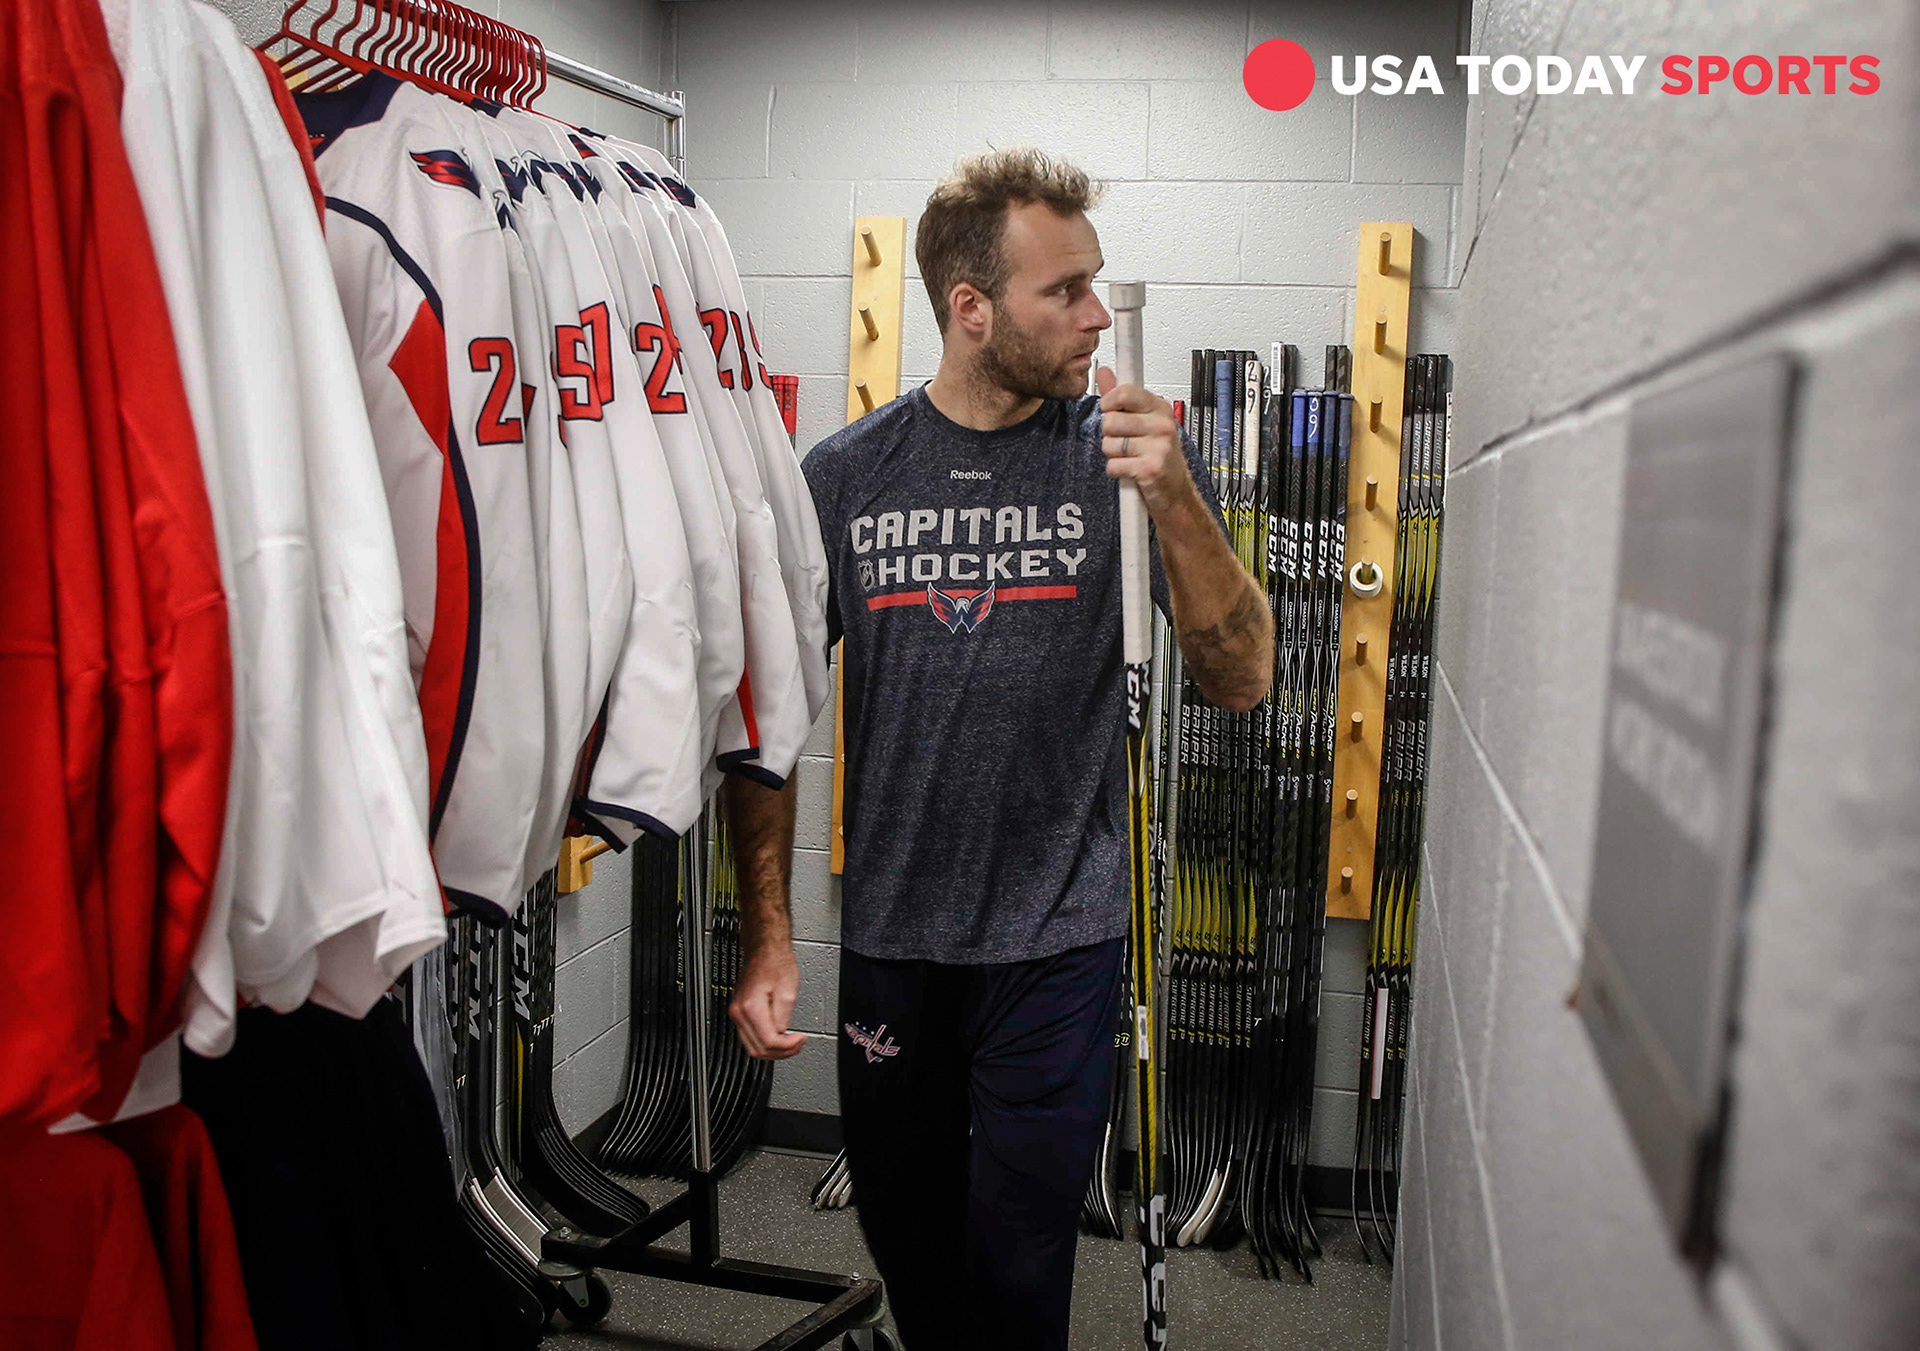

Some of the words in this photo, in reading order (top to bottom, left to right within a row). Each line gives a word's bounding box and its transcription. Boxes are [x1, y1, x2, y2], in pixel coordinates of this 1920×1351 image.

[1247, 361, 1258, 414] 29
[950, 470, 993, 481] Reebok
[851, 502, 1085, 555] CAPITALS
[1268, 515, 1278, 573] CCM
[878, 547, 1087, 586] HOCKEY
[1286, 521, 1298, 580] CCM
[1303, 522, 1313, 580] CCM
[1318, 520, 1329, 578] CCM
[1334, 523, 1345, 582] CCM
[1387, 658, 1395, 680] WILSON
[1410, 655, 1418, 677] WILSON
[1280, 712, 1289, 748] TACKS
[1294, 713, 1303, 748] TACKS
[1309, 710, 1318, 746] TACKS
[1327, 715, 1335, 751] TACKS
